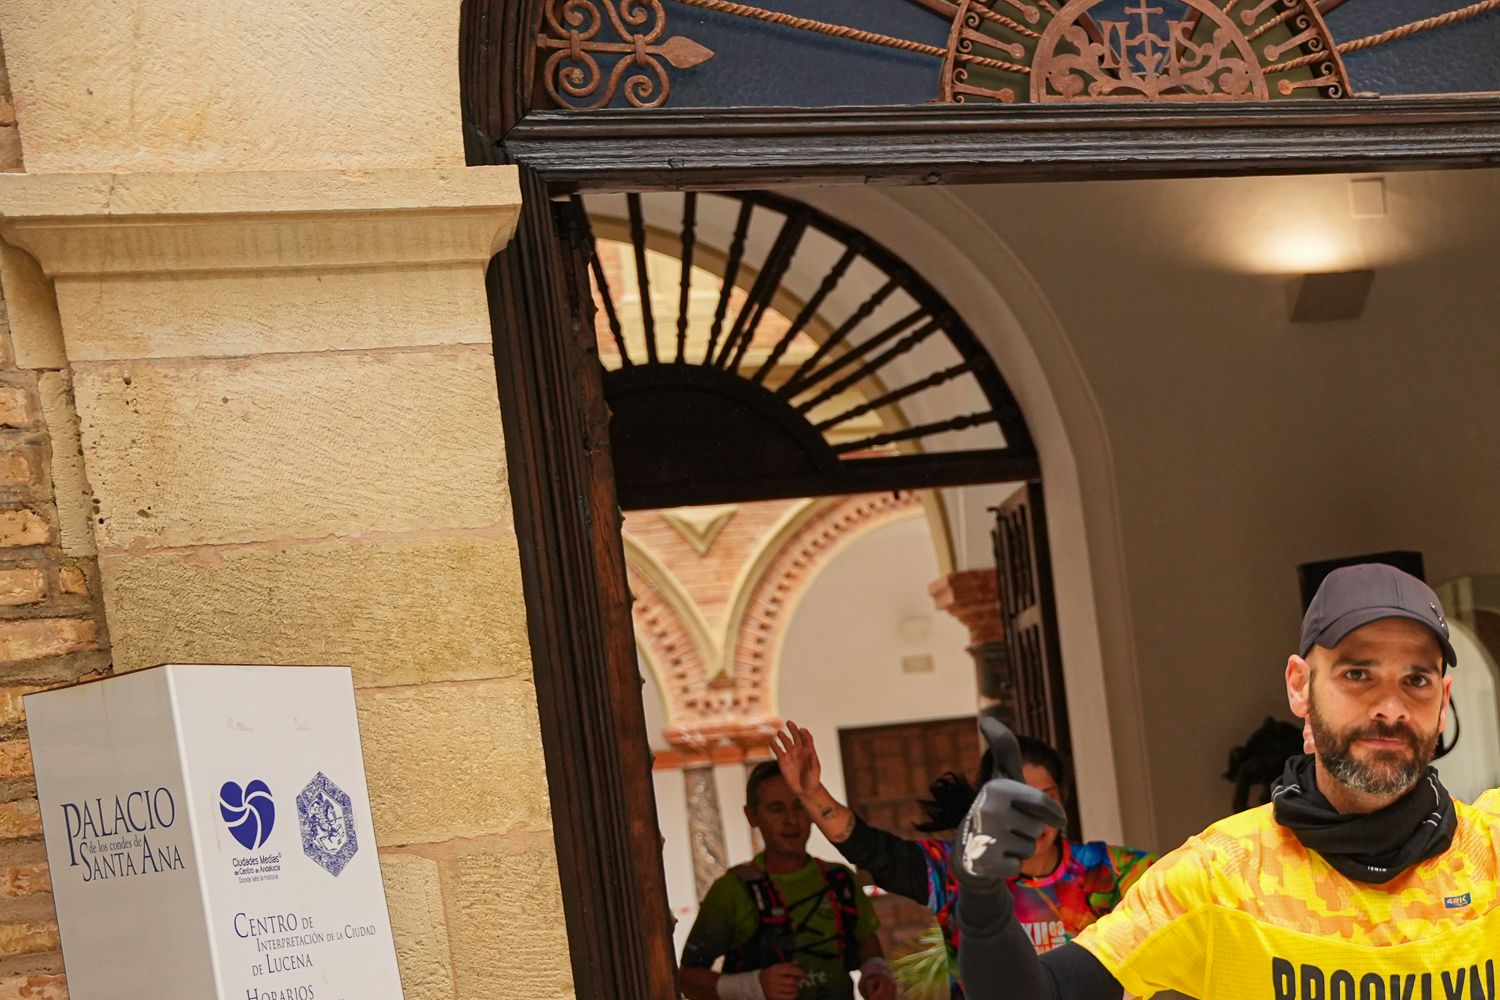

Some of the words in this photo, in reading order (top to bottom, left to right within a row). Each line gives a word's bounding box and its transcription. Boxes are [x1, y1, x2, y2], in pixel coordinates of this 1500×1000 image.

[60, 787, 175, 866] PALACIO
[110, 836, 132, 850] condes
[80, 842, 137, 882] SANTA
[141, 833, 185, 875] ANA
[234, 912, 298, 938] CENTRO
[301, 917, 314, 930] DE
[256, 932, 325, 952] INTERPRETACIÓN
[344, 924, 376, 938] CIUDAD
[252, 964, 264, 976] DE
[266, 953, 314, 974] LUCENA
